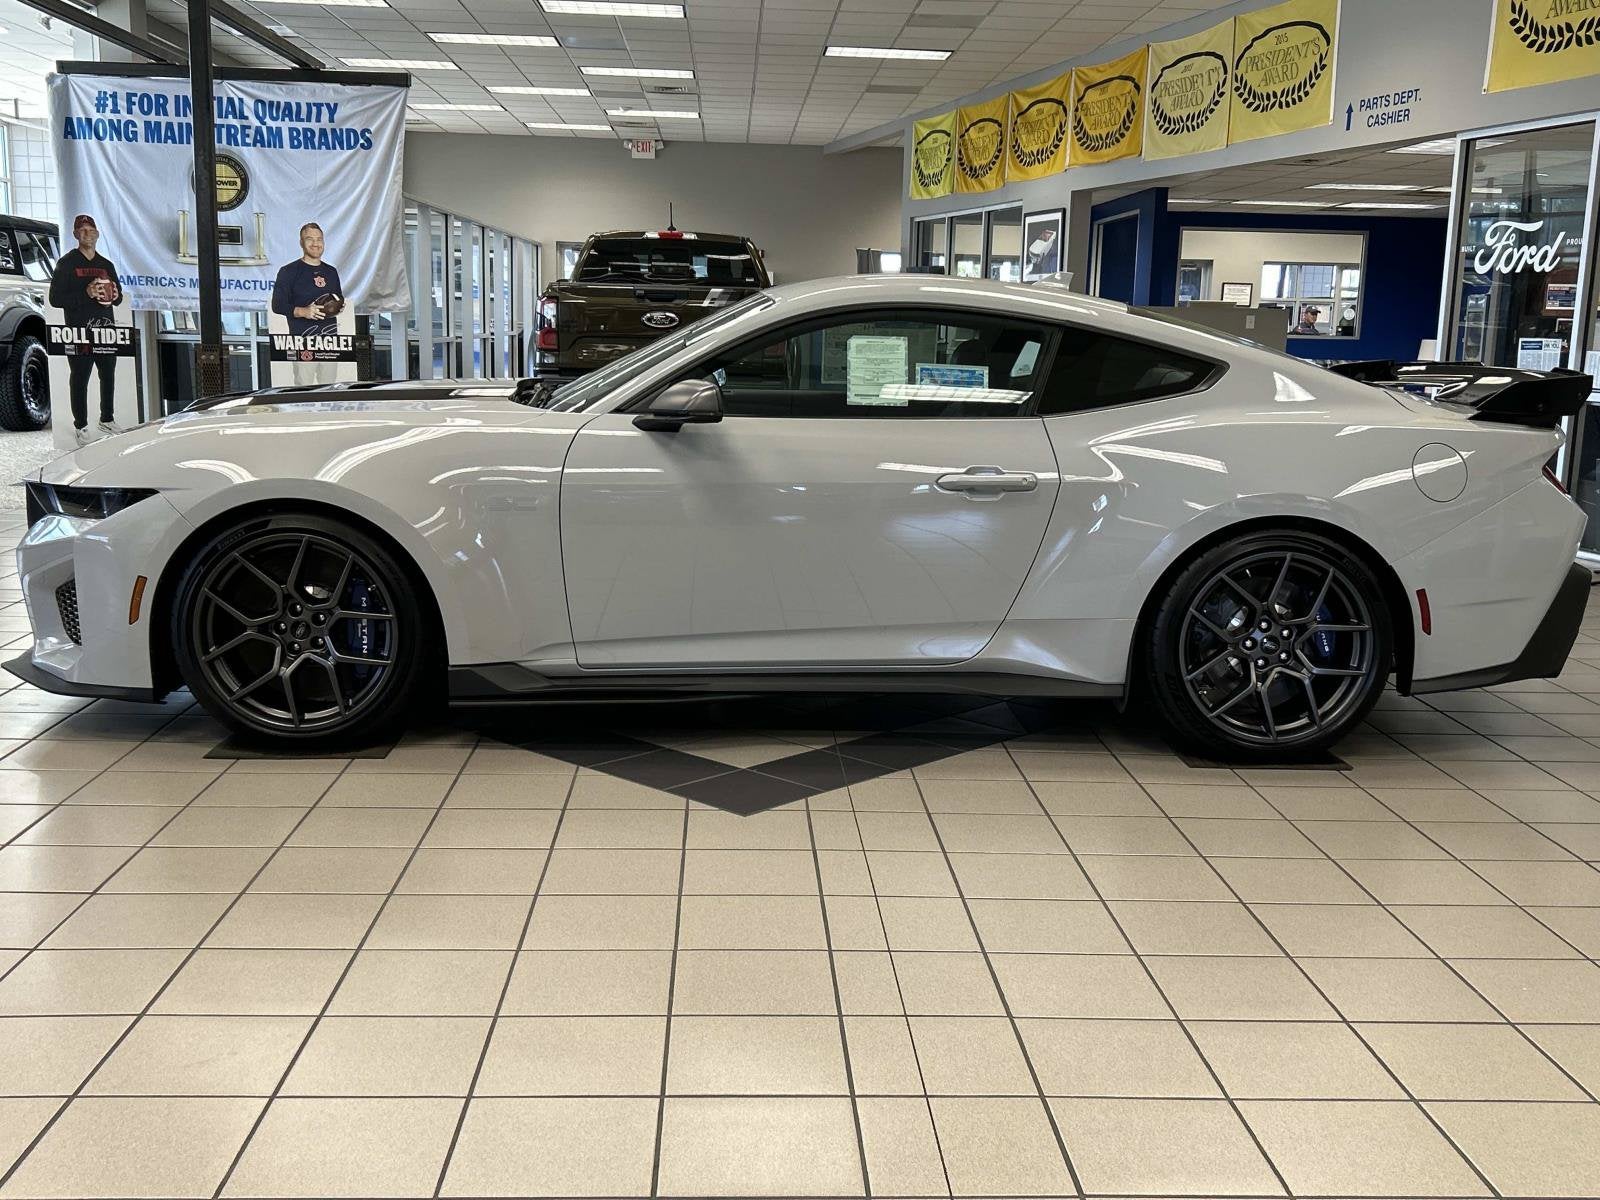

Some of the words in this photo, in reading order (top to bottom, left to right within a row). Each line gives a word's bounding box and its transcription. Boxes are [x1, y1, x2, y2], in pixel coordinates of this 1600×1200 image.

[1275, 33, 1289, 45] 2015
[1257, 62, 1299, 87] AWARD
[95, 91, 121, 115] #1
[125, 92, 169, 117] FOR
[174, 95, 249, 121] INIAL
[253, 99, 339, 126] QUALITY
[1360, 94, 1391, 112] PARTS
[1393, 88, 1422, 106] DEPT.
[1367, 108, 1411, 128] CASHIER
[63, 116, 138, 143] AMONG
[143, 120, 284, 149] MAITREAM
[288, 127, 373, 151] BRANDS
[636, 140, 651, 153] EXIT
[1474, 220, 1566, 275] Ford
[1566, 237, 1583, 246] PROU
[118, 275, 186, 289] AMERICA'S
[189, 277, 276, 291] MUFACTUR
[50, 326, 90, 344] ROLL
[91, 327, 131, 345] TIDE!
[273, 335, 305, 351] WAR
[306, 335, 353, 351] EAGLE!
